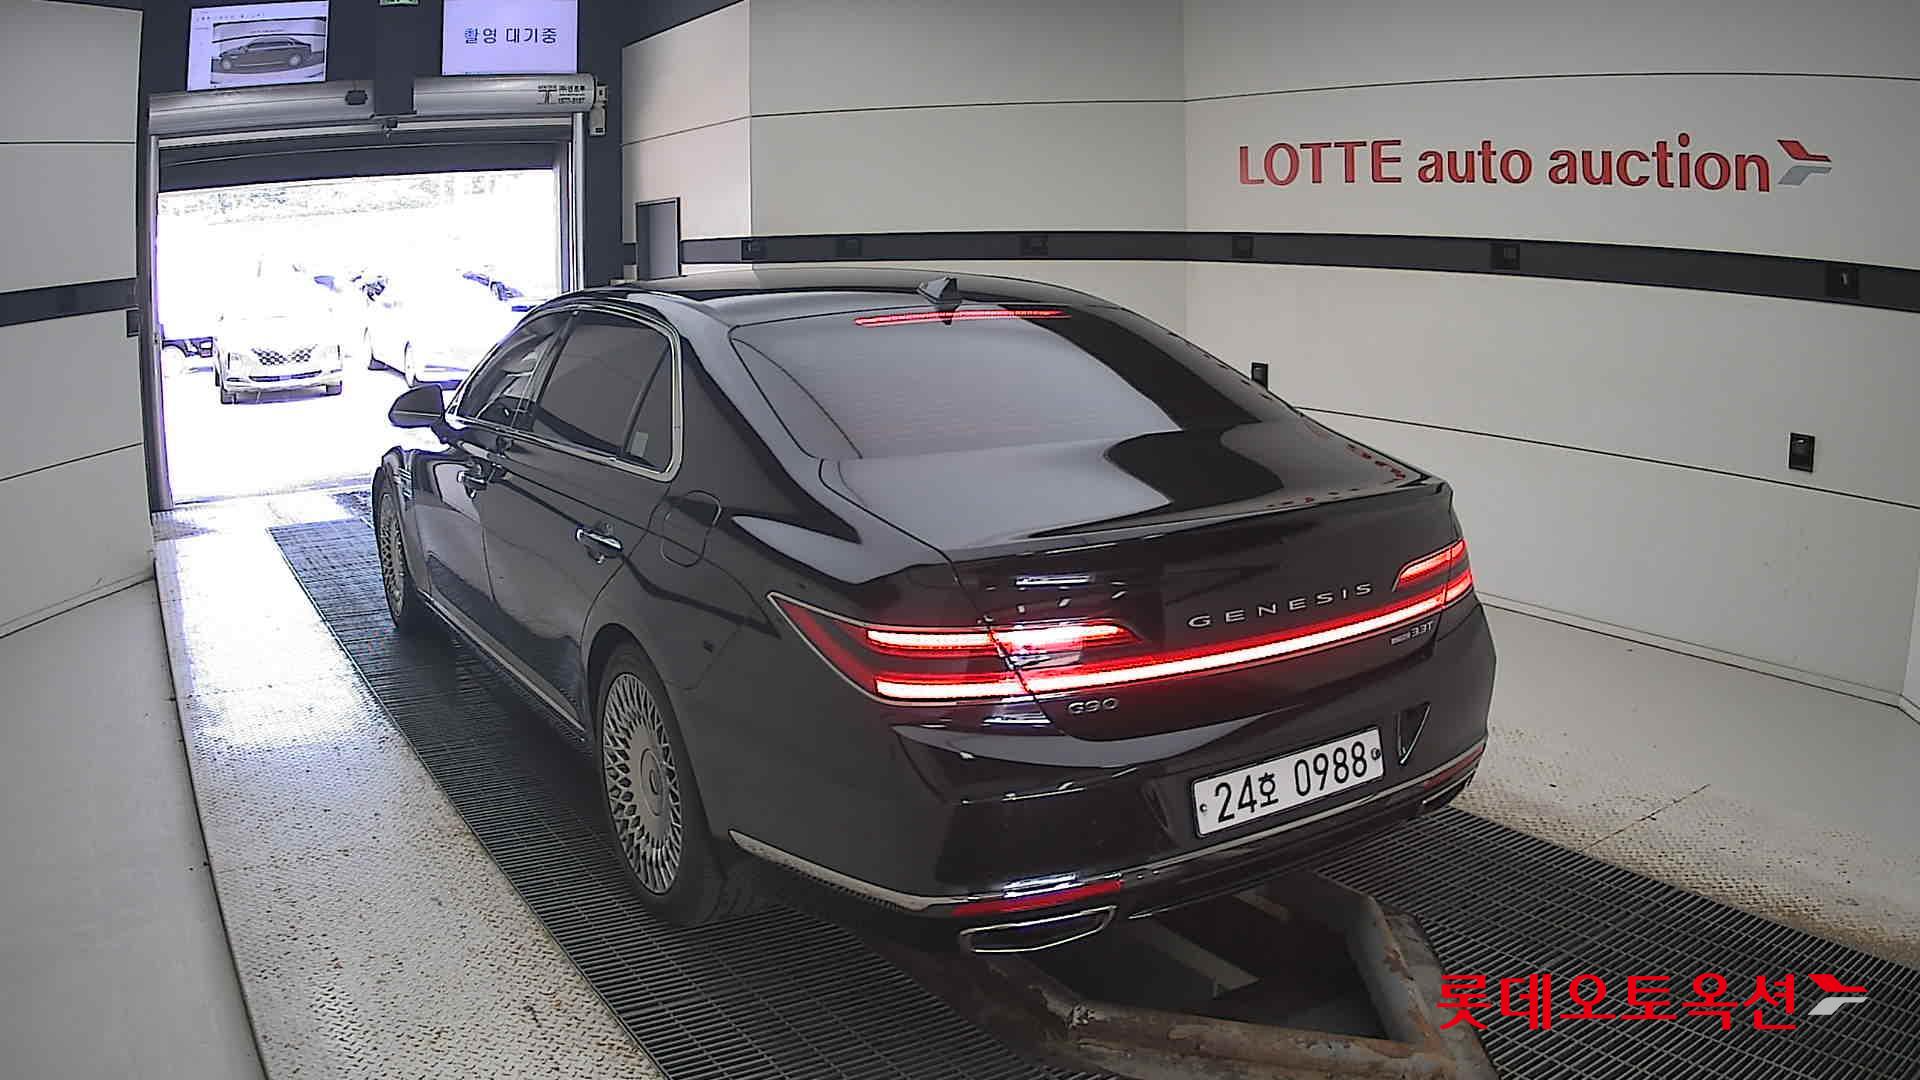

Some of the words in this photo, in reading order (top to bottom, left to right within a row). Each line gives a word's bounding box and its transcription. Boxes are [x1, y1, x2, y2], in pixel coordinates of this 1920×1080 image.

[506, 27, 558, 44] 대기중
[1239, 140, 1402, 185] LOTTE
[1417, 141, 1533, 184] auto
[1548, 133, 1770, 192] auction
[1188, 583, 1372, 628] GENESIS
[1068, 698, 1119, 714] G90
[1214, 772, 1279, 823] 24호
[1294, 741, 1367, 796] 0988
